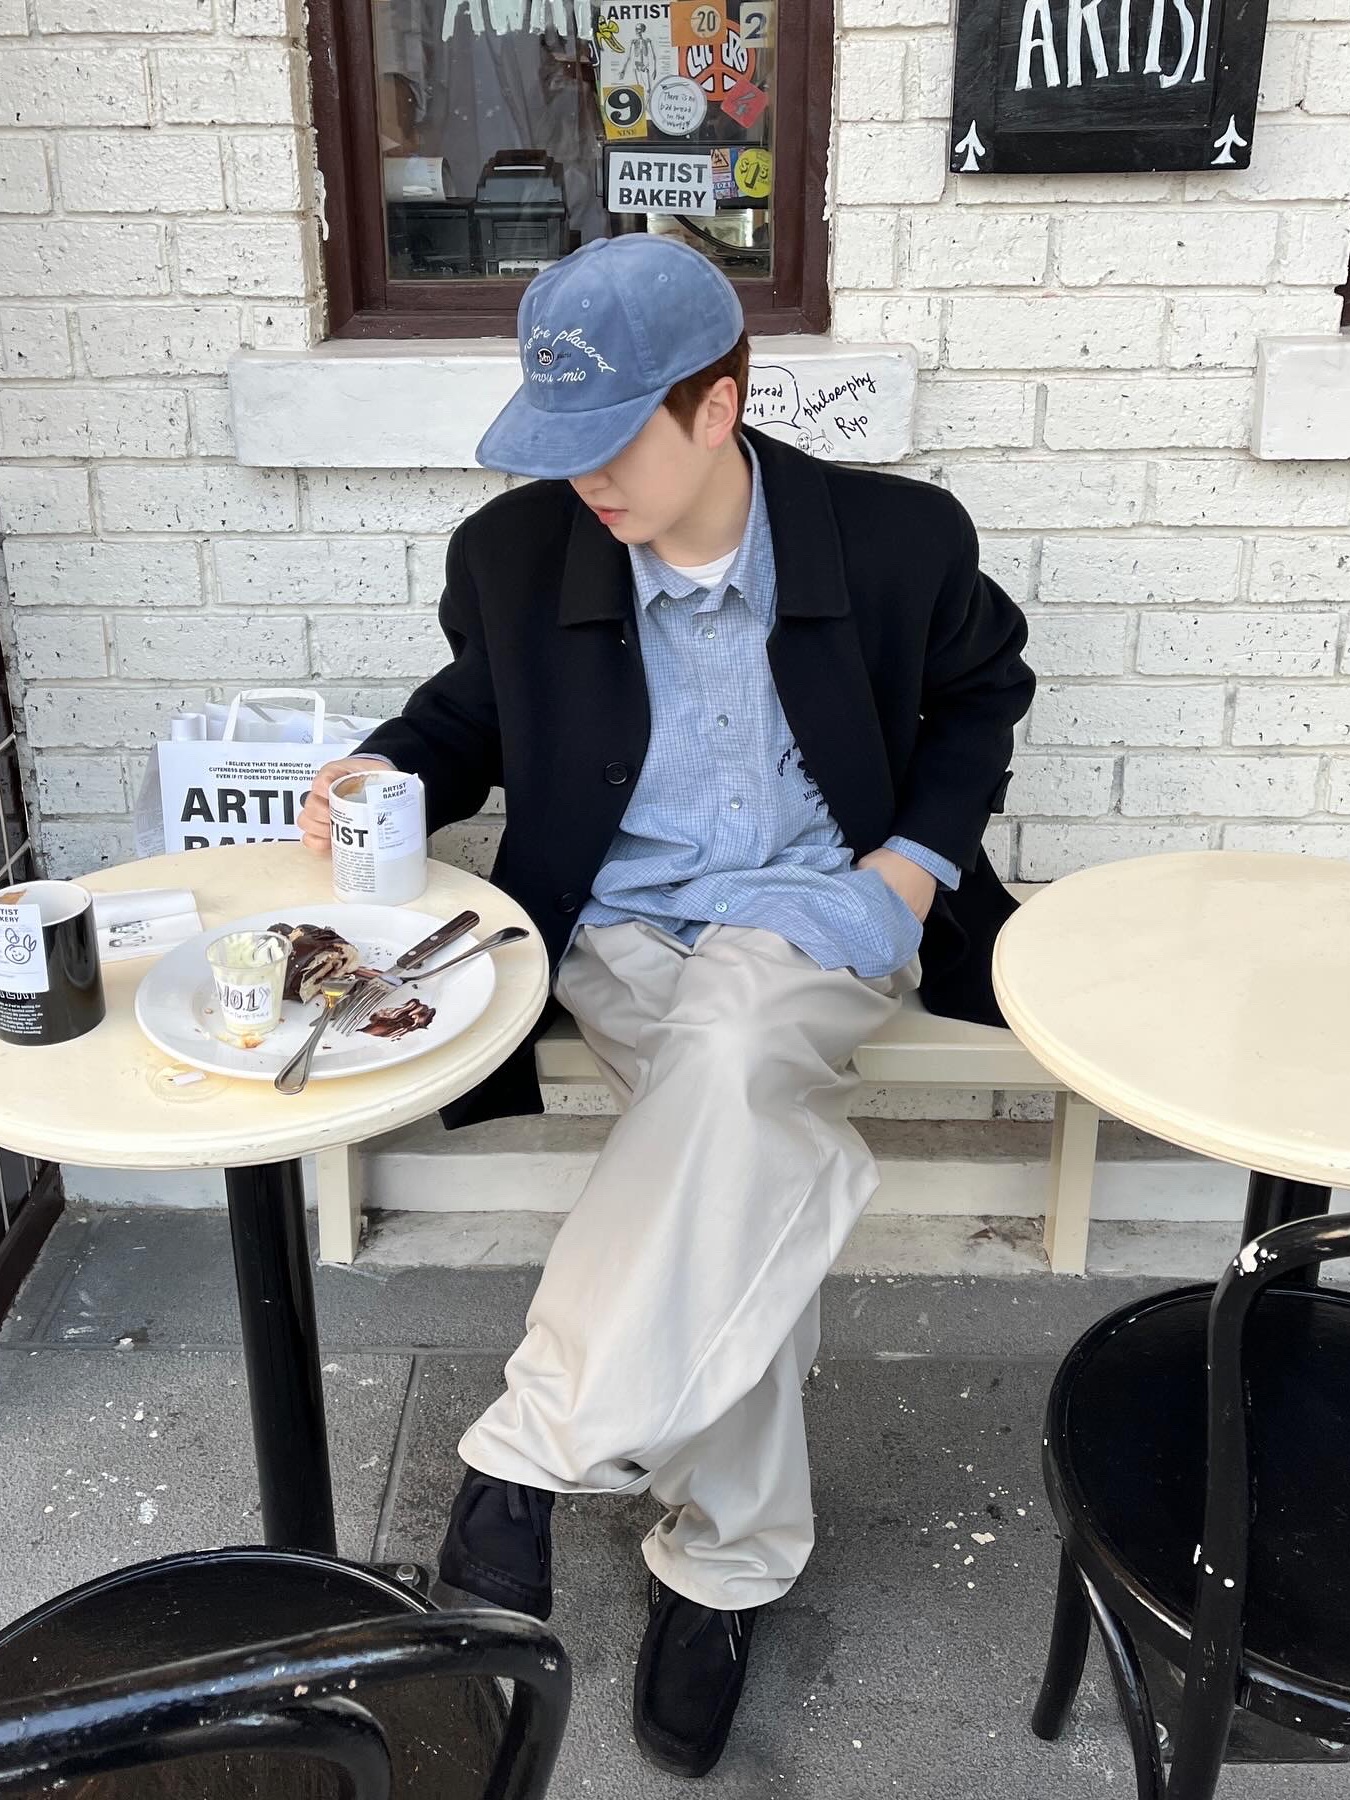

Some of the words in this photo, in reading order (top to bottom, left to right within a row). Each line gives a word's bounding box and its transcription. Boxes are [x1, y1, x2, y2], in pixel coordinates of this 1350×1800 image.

[697, 11, 716, 33] 20
[744, 13, 767, 40] 2
[607, 89, 643, 126] 9
[619, 160, 708, 184] ARTIST
[618, 187, 707, 209] BAKERY
[557, 367, 587, 382] mio
[750, 383, 783, 398] bread
[802, 372, 876, 423] philosophy
[834, 415, 868, 440] Ryo
[382, 782, 407, 794] ARTIST
[382, 789, 407, 799] BAKERY
